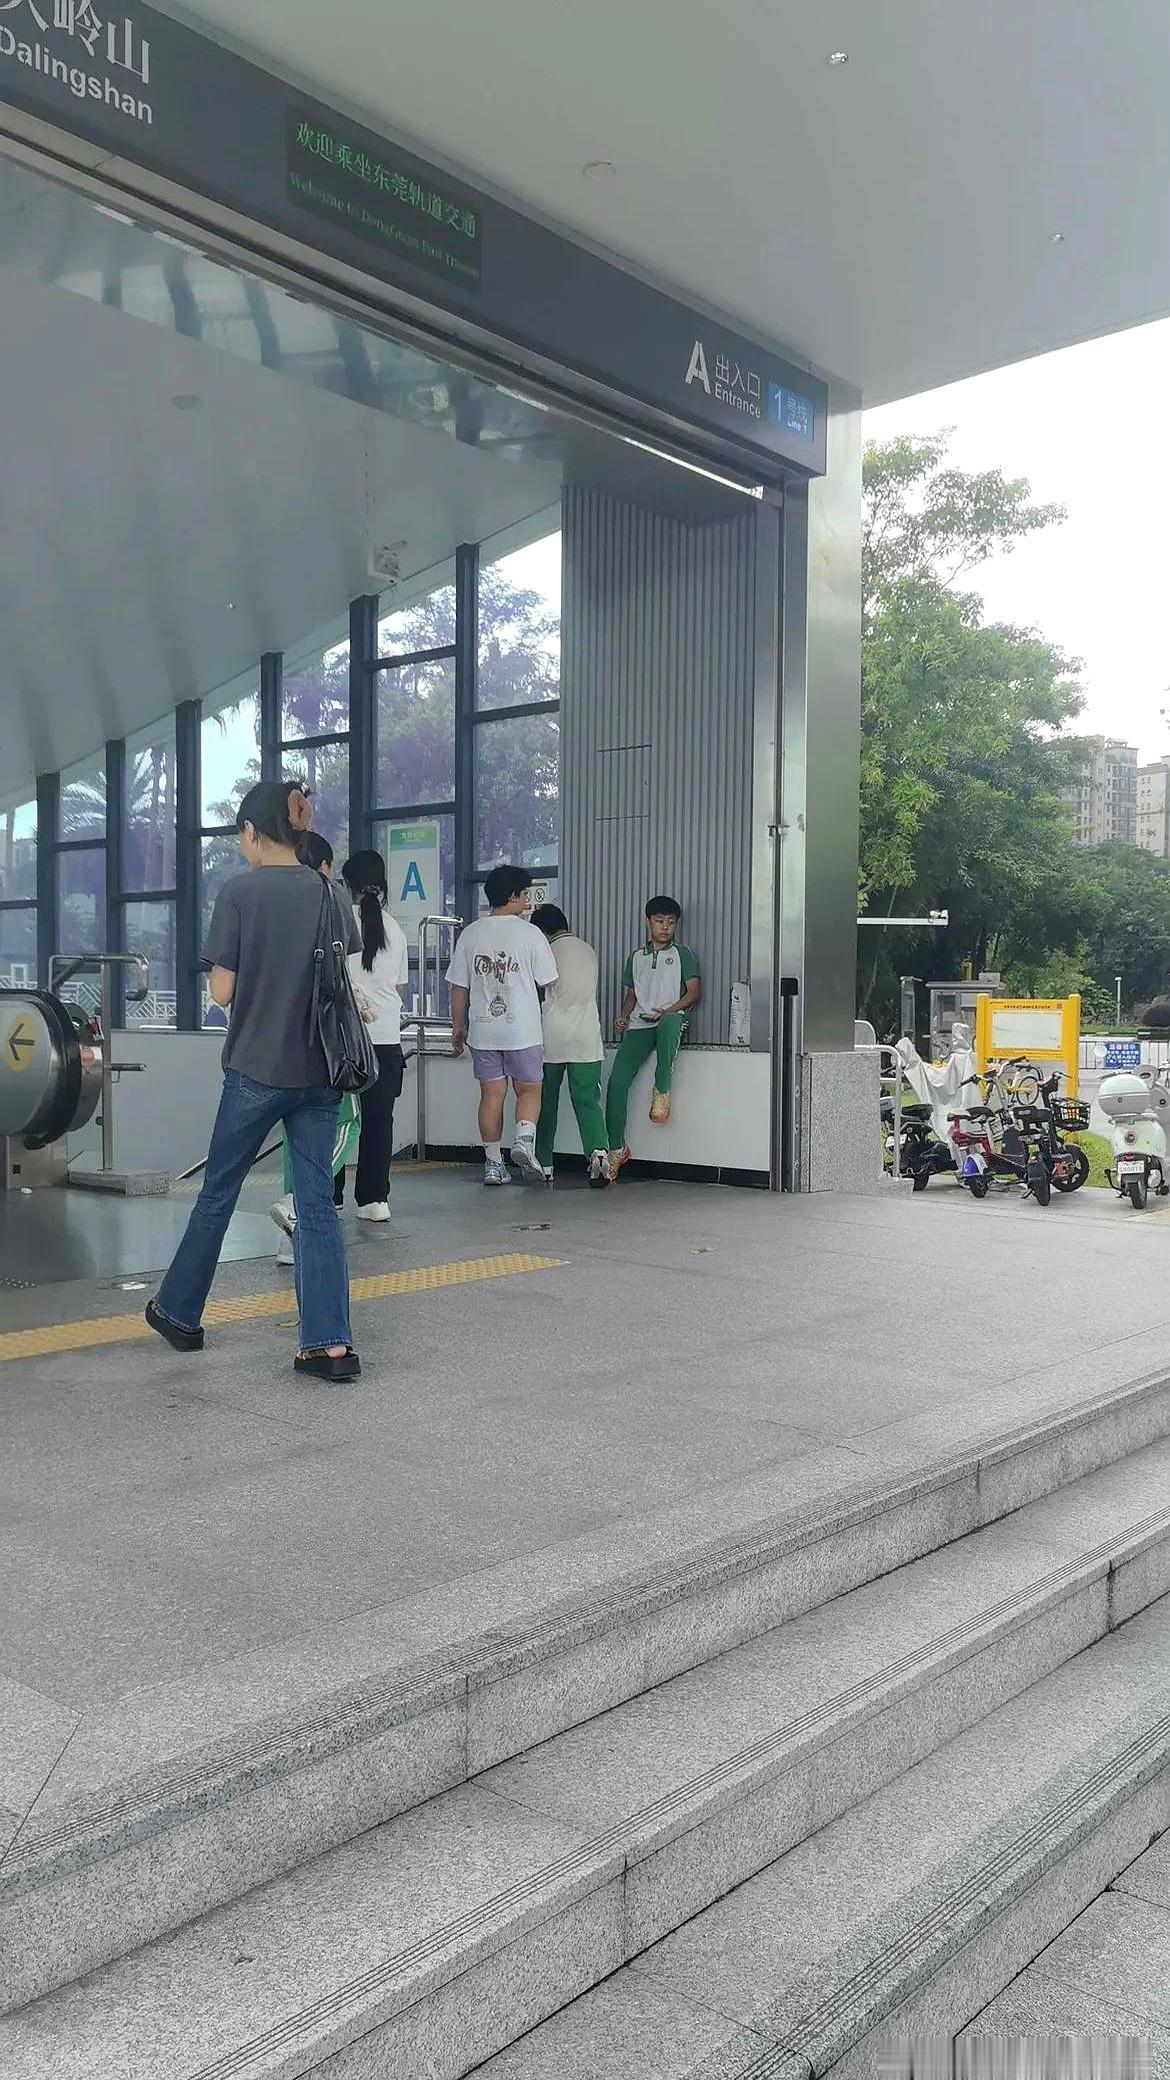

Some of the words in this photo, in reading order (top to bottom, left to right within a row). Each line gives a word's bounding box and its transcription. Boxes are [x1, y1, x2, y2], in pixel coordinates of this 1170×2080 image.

[0, 25, 152, 125] Dalingshan
[296, 122, 477, 239] 欢迎乘坐东莞轨道交通
[685, 340, 711, 394] A
[715, 354, 761, 400] 出入口
[714, 383, 761, 418] Entrance
[400, 861, 426, 901] A
